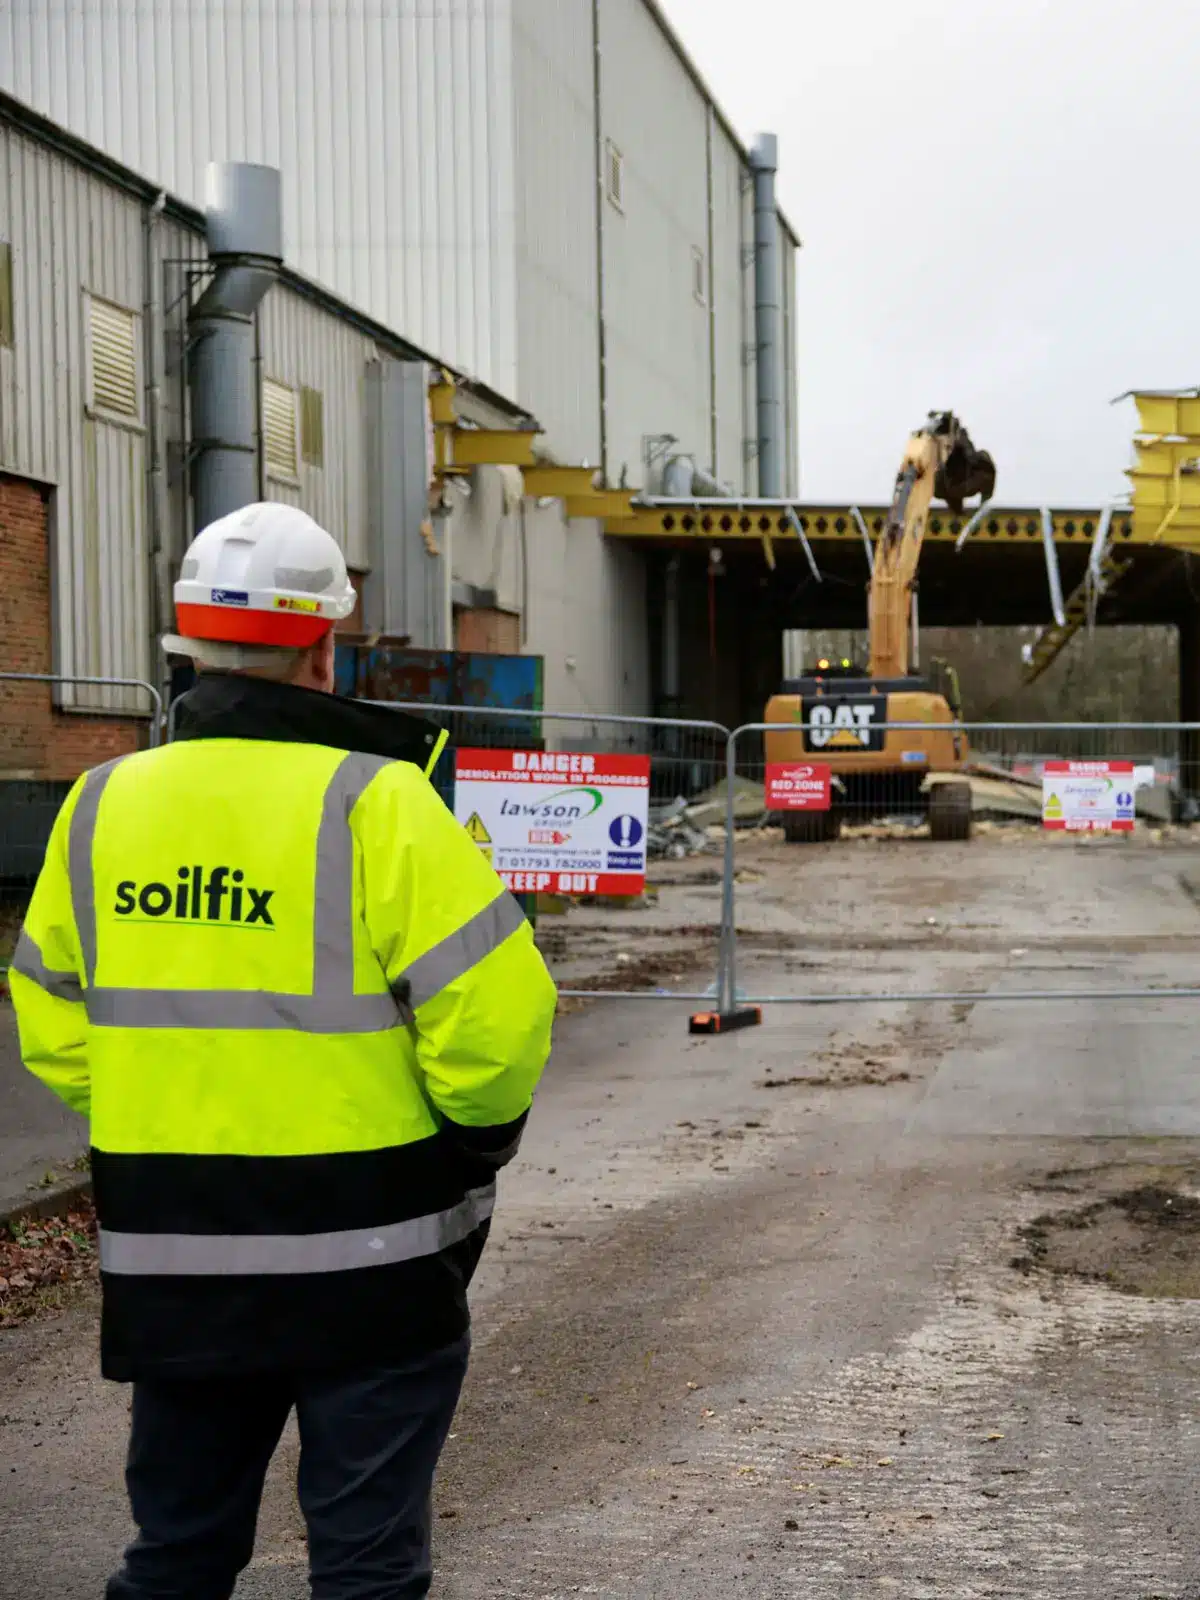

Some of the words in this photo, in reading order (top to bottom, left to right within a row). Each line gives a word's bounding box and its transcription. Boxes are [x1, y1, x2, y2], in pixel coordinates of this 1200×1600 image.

[809, 704, 876, 747] CAT
[512, 752, 596, 773] DANGER
[456, 769, 530, 781] DEMOLITION
[532, 772, 568, 783] WORK
[570, 773, 584, 783] IN
[586, 774, 649, 786] PROGRESS
[500, 799, 581, 818] lawson
[510, 857, 550, 868] 01793
[501, 872, 550, 891] KEEP
[558, 874, 599, 892] OUT
[114, 866, 275, 925] soilfix
